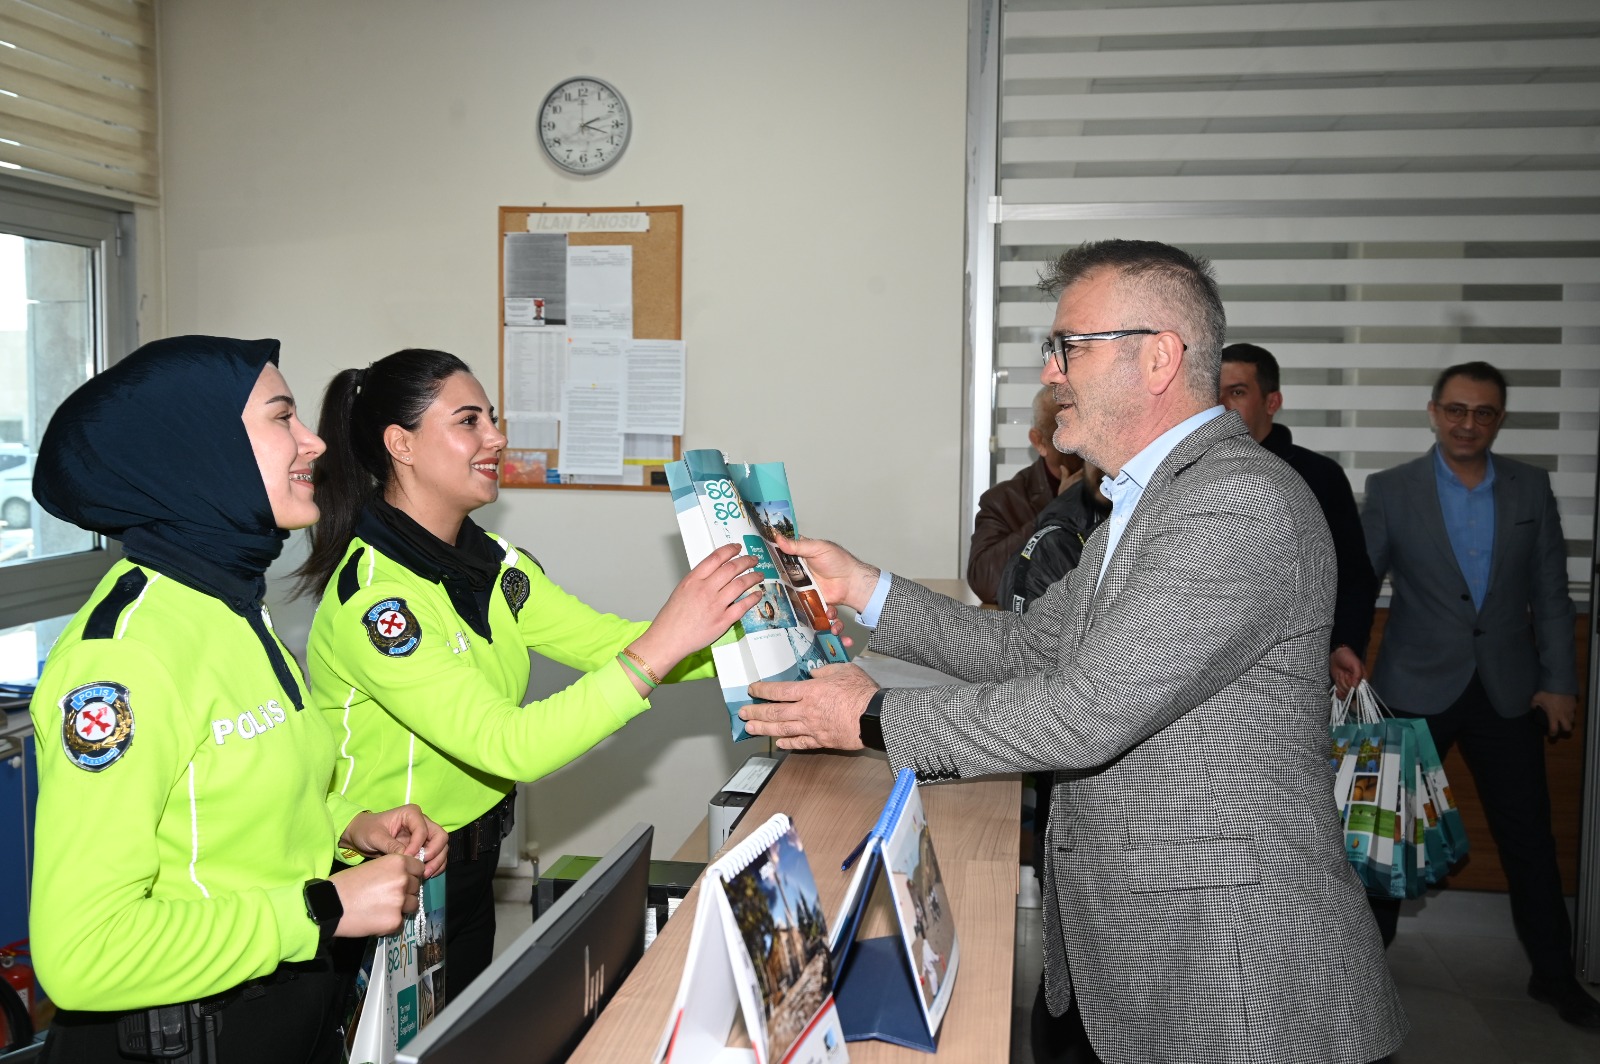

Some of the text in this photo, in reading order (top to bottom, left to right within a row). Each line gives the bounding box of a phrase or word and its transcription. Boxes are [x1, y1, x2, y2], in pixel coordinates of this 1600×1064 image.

[565, 92, 571, 101] 11
[578, 88, 588, 97] 12
[552, 105, 562, 114] 10
[607, 103, 615, 113] 2
[547, 121, 556, 131] 9
[611, 119, 619, 129] 3
[552, 137, 561, 147] 8
[606, 135, 614, 145] 4
[565, 149, 573, 159] 7
[579, 153, 588, 163] 6
[594, 148, 603, 158] 5
[577, 214, 641, 229] PANOSU
